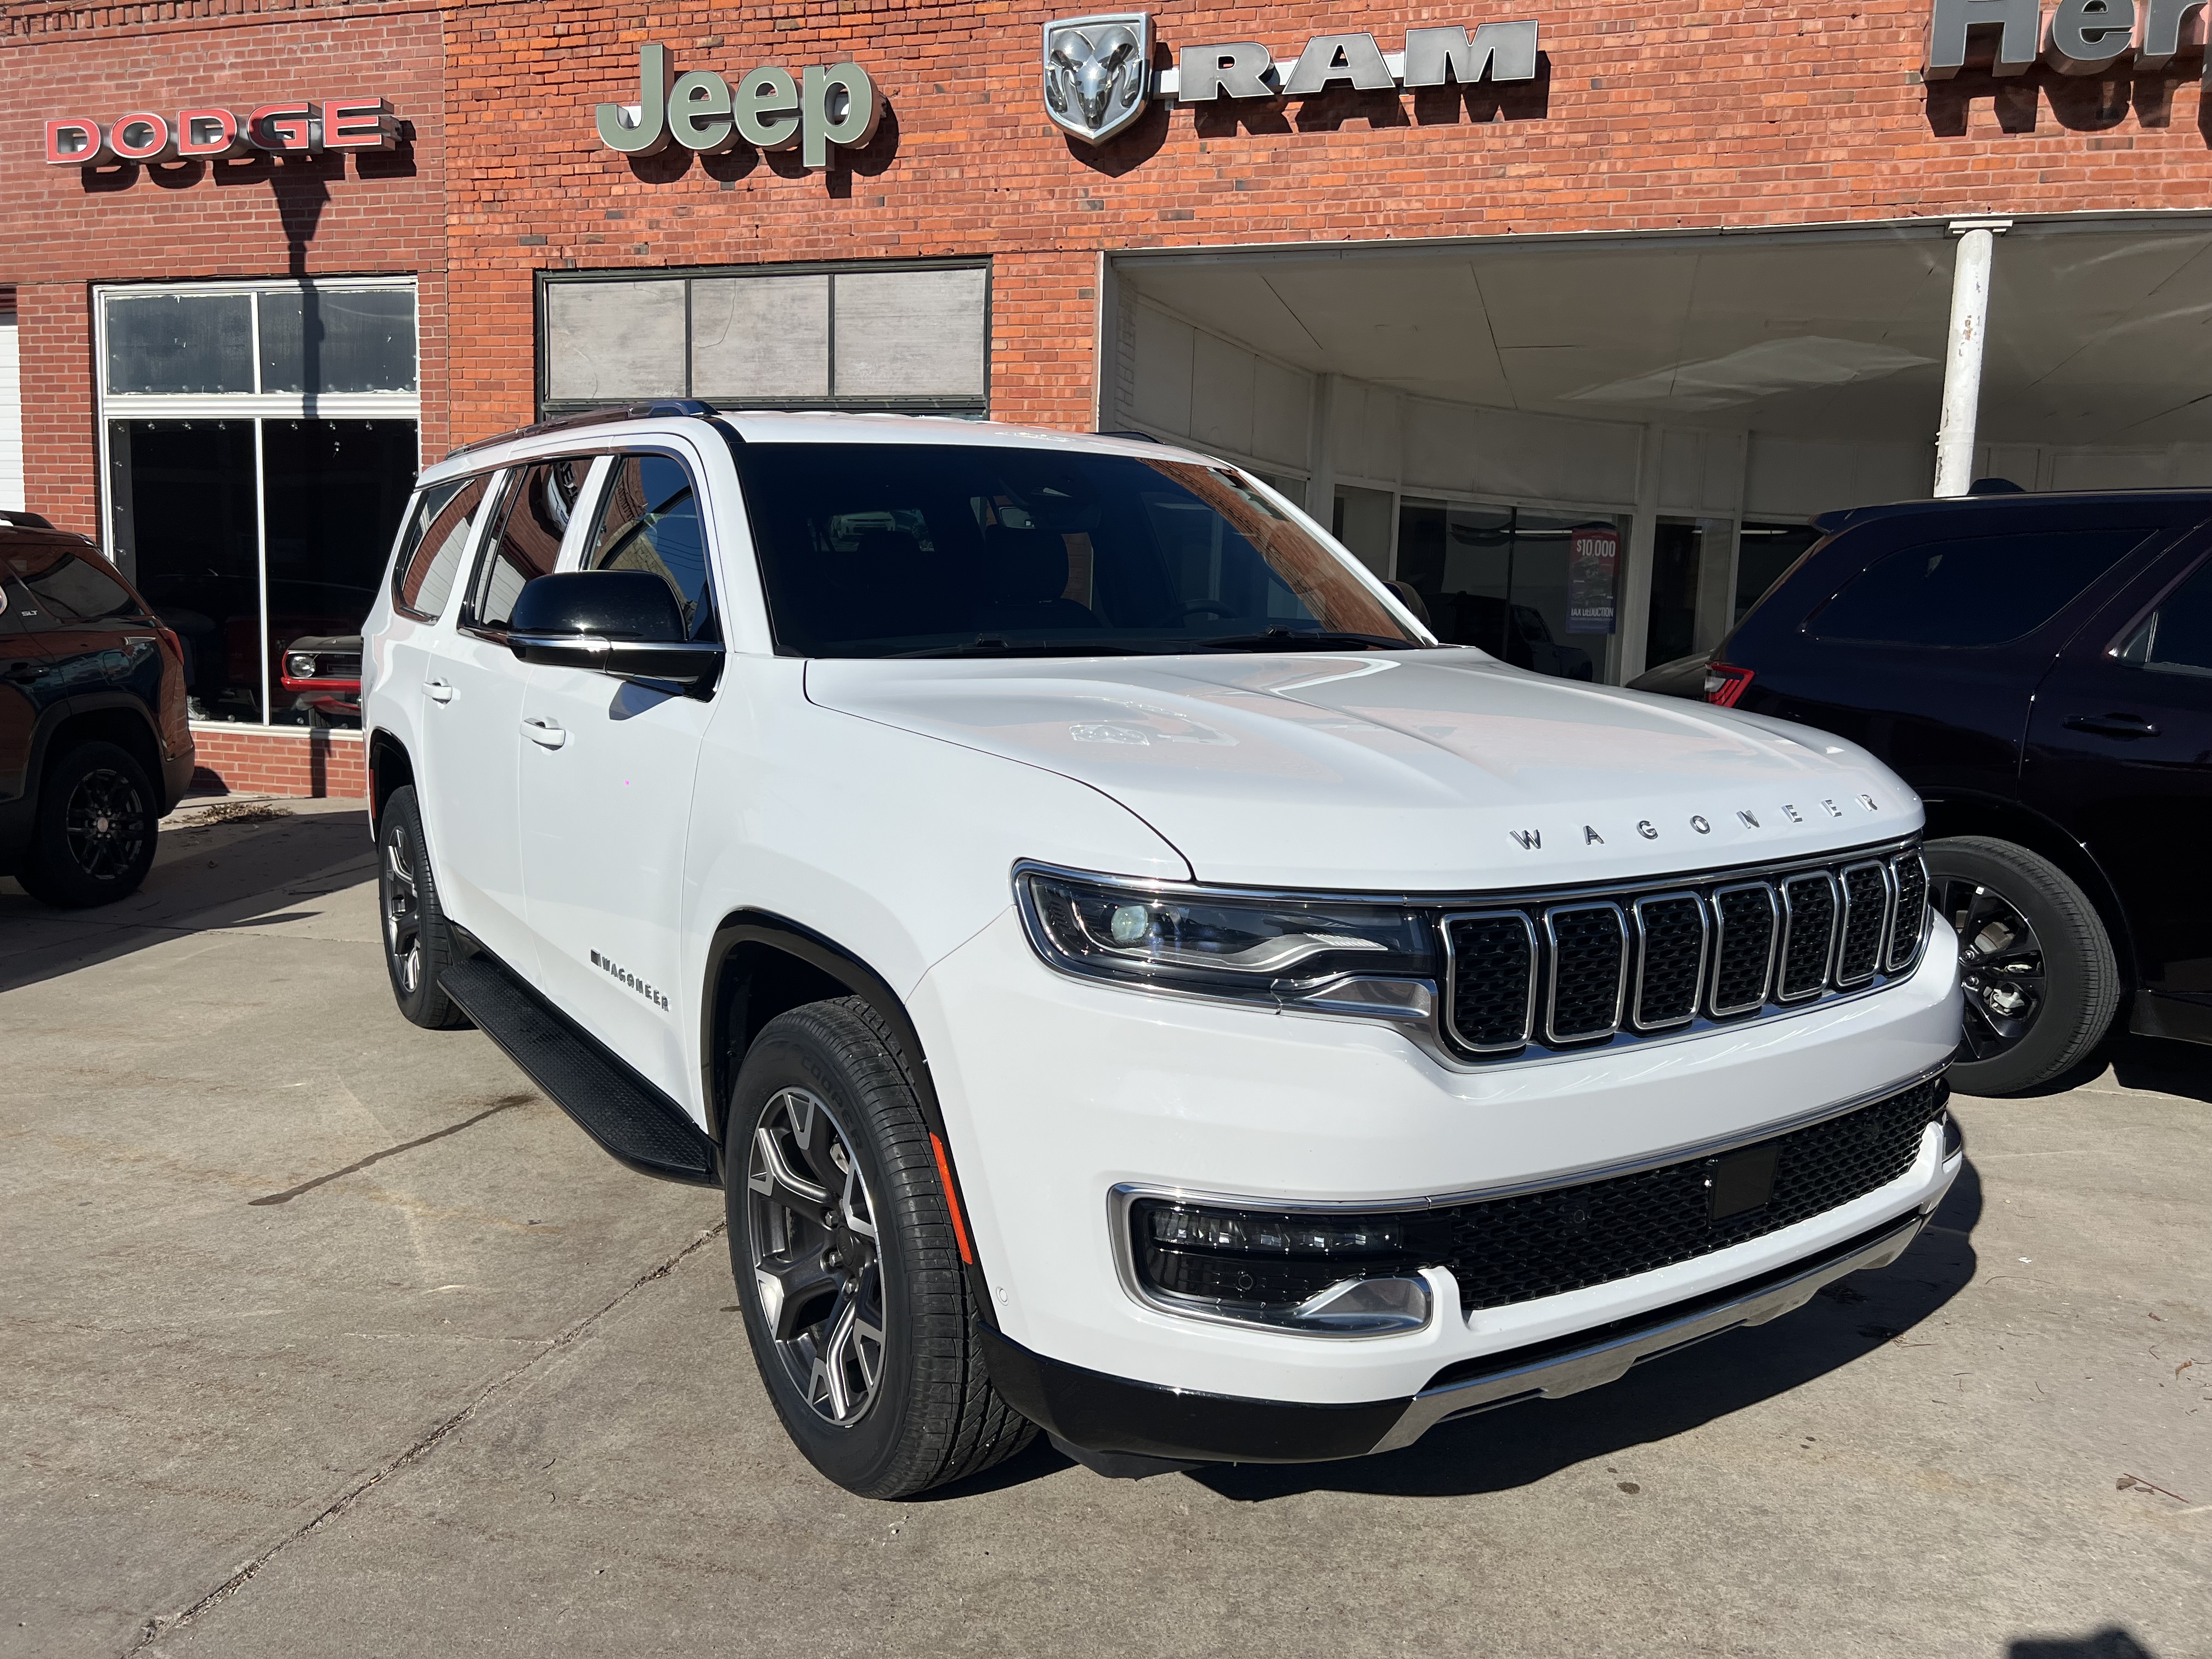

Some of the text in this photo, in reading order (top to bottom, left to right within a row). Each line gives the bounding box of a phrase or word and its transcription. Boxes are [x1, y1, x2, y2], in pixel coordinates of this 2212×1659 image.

[1179, 20, 1538, 101] RAM
[1929, 0, 2212, 67] Her
[45, 97, 385, 165] DODGE
[596, 43, 873, 168] Jeep
[1577, 539, 1616, 557] $10,000
[1582, 607, 1613, 617] DEDUCTION
[1509, 794, 1878, 850] WAGONEER
[601, 956, 670, 1013] WAGONEER
